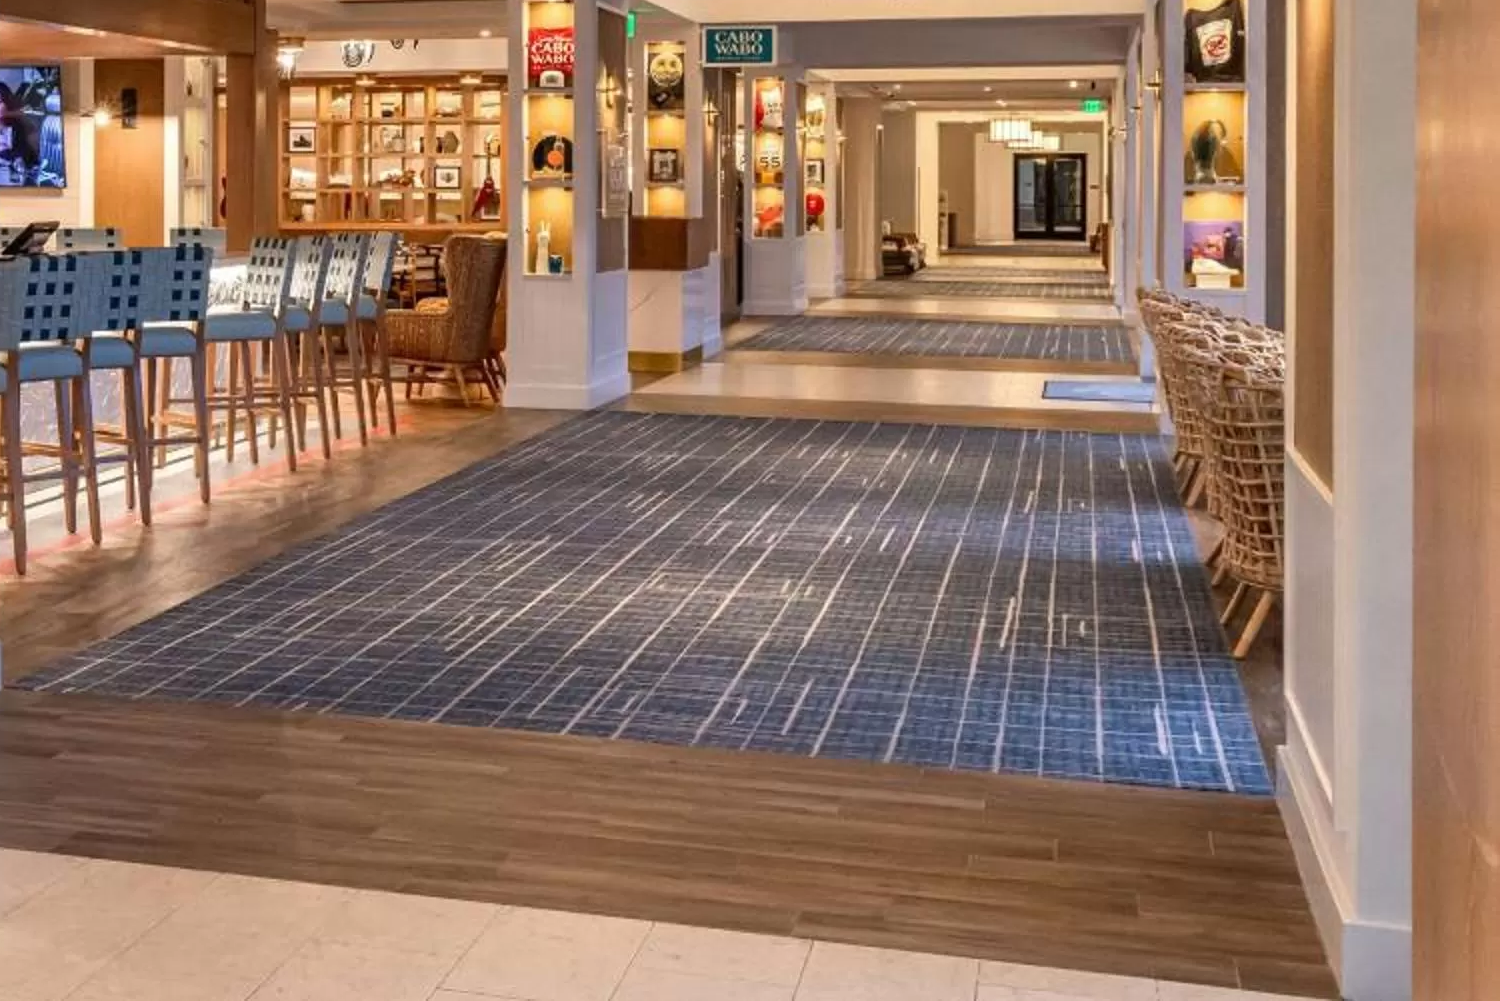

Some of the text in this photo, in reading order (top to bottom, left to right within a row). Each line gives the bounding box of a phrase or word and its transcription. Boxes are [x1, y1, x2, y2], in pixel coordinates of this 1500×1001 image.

[715, 30, 764, 43] CABO
[531, 42, 575, 54] CABO
[714, 42, 764, 56] WABO
[531, 54, 575, 64] WABO
